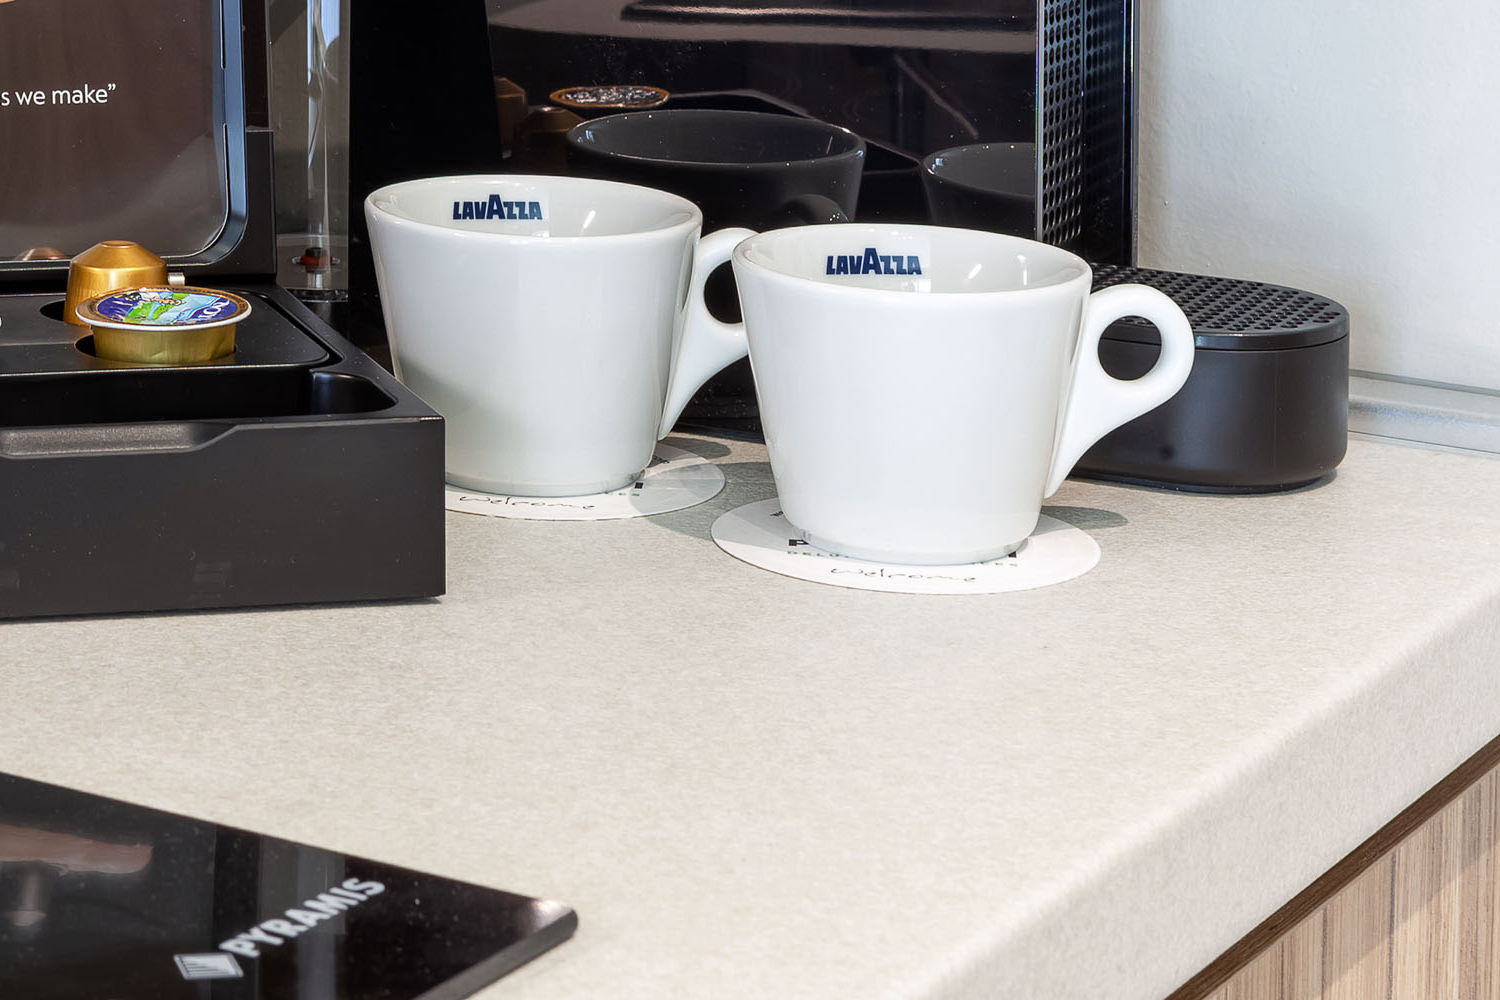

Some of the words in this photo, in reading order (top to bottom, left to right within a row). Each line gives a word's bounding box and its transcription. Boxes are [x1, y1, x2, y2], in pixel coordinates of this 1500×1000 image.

[15, 90, 46, 106] we
[452, 193, 543, 220] LAVAZZA
[825, 247, 923, 275] LAVAZZA
[218, 876, 386, 959] PYRAMIS
